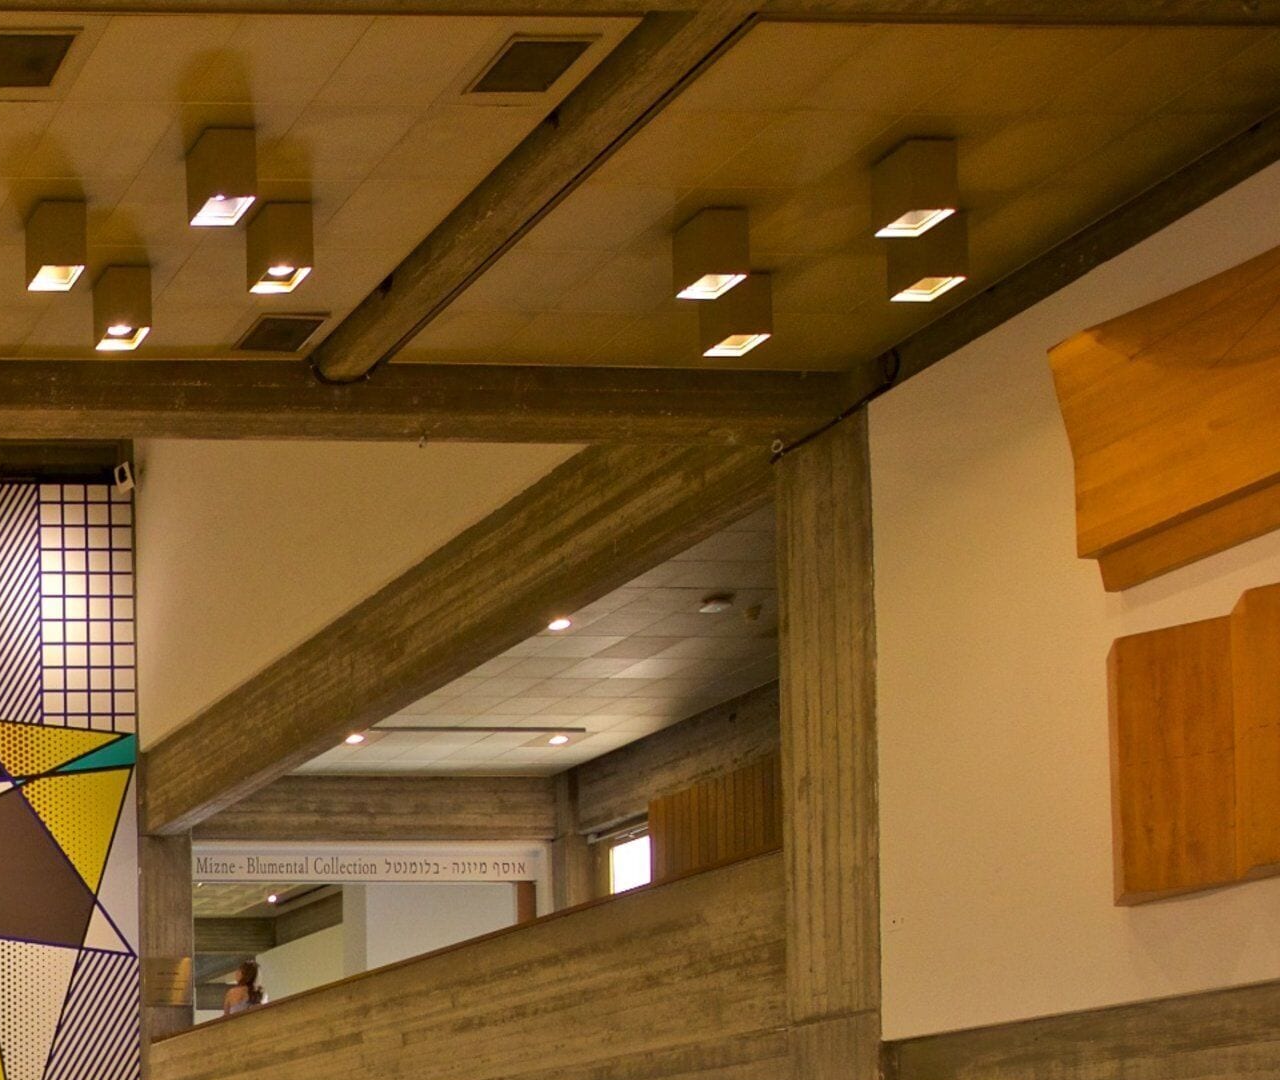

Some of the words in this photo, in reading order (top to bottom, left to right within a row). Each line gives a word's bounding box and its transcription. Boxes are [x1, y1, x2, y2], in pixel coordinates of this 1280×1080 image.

[196, 857, 235, 874] Mizne
[247, 856, 309, 875] Blumental
[313, 856, 377, 875] Collection
[384, 858, 440, 875] בלומנטל
[452, 861, 487, 875] מיזנה
[493, 861, 526, 876] אוסף
